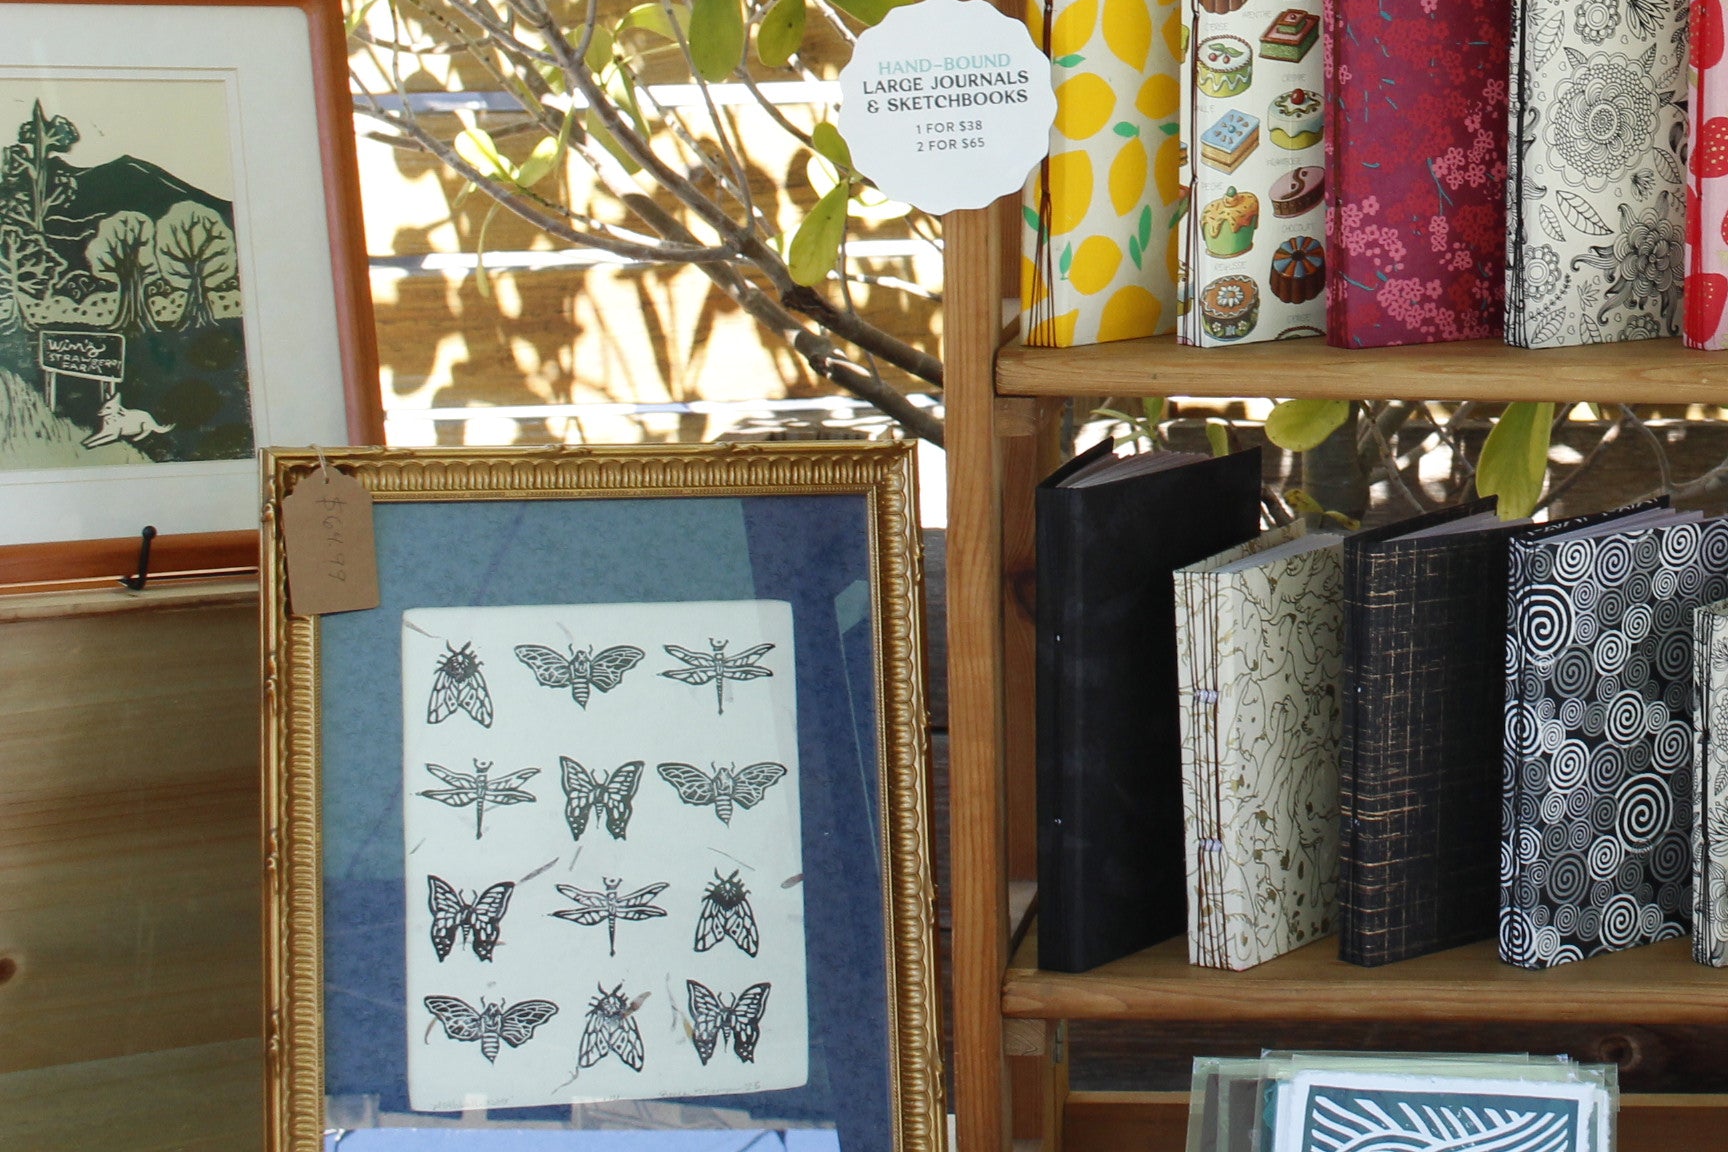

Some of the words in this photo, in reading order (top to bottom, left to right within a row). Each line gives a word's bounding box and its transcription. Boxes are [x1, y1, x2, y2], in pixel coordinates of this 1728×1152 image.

[878, 53, 1011, 76] HAND-BOUND
[863, 77, 924, 95] LARGE
[931, 70, 1029, 90] JOURNALS
[867, 99, 880, 114] &
[887, 89, 1029, 112] SKETCHBOOKS
[916, 124, 921, 134] 1
[926, 122, 955, 134] FOR
[959, 120, 983, 132] $38
[917, 141, 924, 152] 2
[929, 139, 957, 151] FOR
[962, 137, 985, 149] $65
[61, 362, 103, 374] FARM
